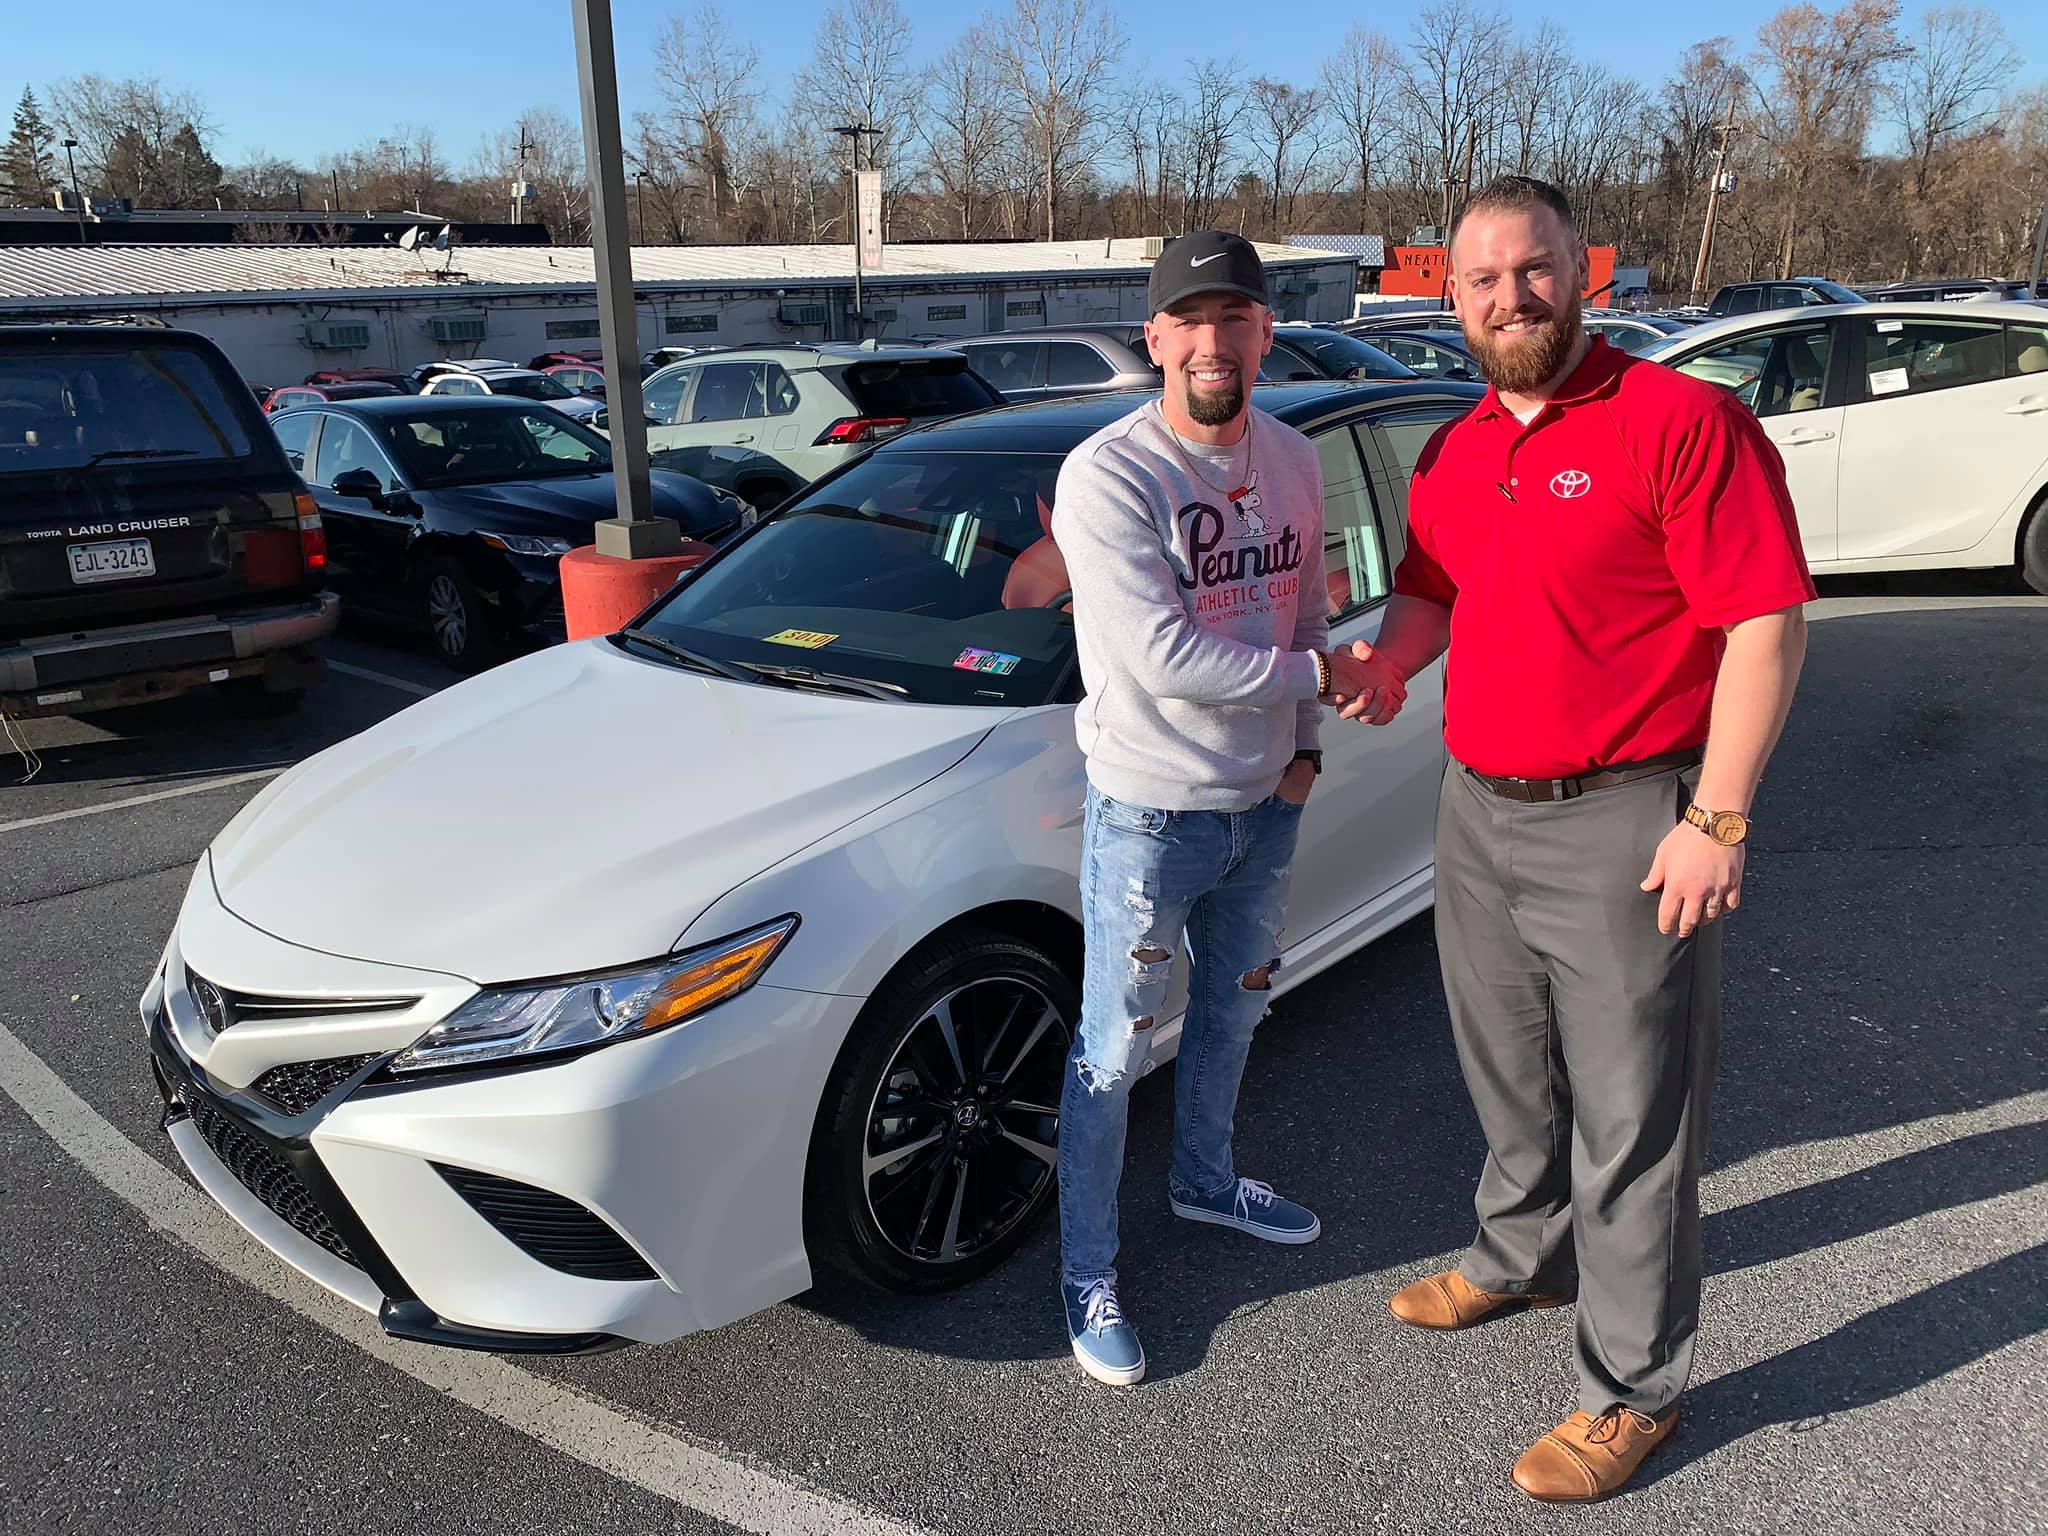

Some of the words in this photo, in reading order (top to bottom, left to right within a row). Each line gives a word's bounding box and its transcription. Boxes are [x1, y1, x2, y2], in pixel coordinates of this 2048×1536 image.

[26, 530, 62, 539] TOYOTA
[69, 523, 114, 537] LAND
[118, 516, 190, 533] CRUISER
[1178, 501, 1303, 589] Peanuts
[1196, 585, 1259, 614] ATHLETIC
[1267, 577, 1298, 599] CLUB
